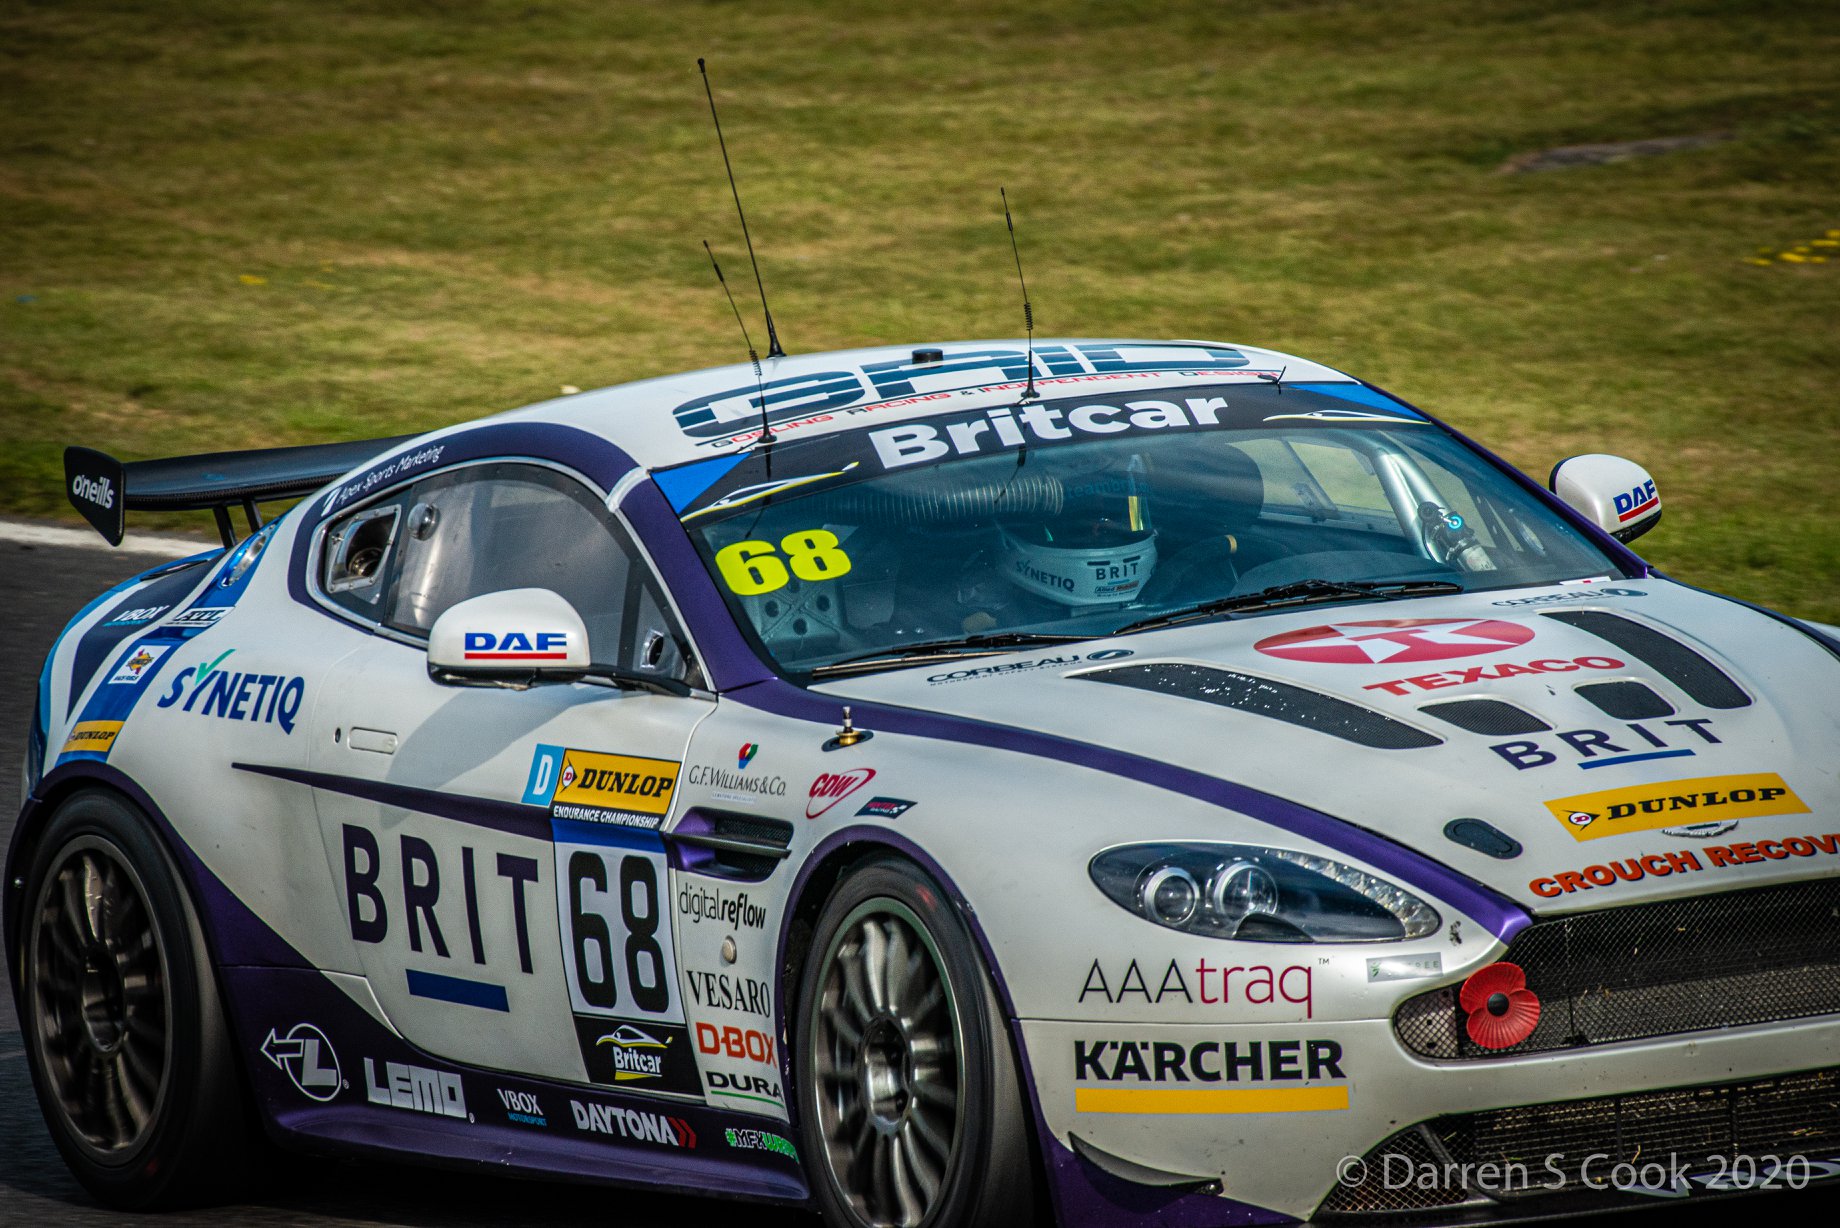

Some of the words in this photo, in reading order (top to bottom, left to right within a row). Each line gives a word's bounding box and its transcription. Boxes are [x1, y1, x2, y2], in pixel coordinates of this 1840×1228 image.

[846, 393, 952, 416] RACING
[979, 371, 1161, 393] INDEPENDENT
[868, 396, 1228, 469] Britcar
[363, 465, 396, 492] Sports
[395, 445, 445, 473] Marketing
[1612, 478, 1656, 515] DAF
[714, 528, 852, 596] 68
[1015, 559, 1075, 592] SYNETIQ
[1095, 563, 1139, 581] BRIT
[112, 604, 171, 622] VBOX
[464, 632, 567, 651] DAF
[926, 654, 1080, 683] CORBEAU
[1362, 655, 1626, 697] TEXACO
[157, 648, 305, 736] SYNETIQ
[75, 730, 116, 741] DUNLOP
[1488, 717, 1723, 772] BRIT
[532, 754, 554, 796] D
[577, 767, 674, 798] DUNLOP
[808, 772, 860, 798] CDW
[553, 804, 601, 822] ENDURANCE
[600, 811, 660, 829] CHAMPIONSHIP
[1606, 787, 1786, 821] DUNLOP
[1529, 849, 1702, 898] CROUCH
[342, 823, 539, 975] BRIT
[568, 850, 671, 1014] 68
[686, 969, 771, 1019] VESARO
[1078, 956, 1313, 1020] AAAtraq
[612, 1045, 662, 1074] Britcar
[695, 1021, 778, 1069] D-BOX
[1074, 1039, 1348, 1082] KÄRCHER
[363, 1056, 468, 1119] LEMO
[497, 1087, 544, 1116] VBOX
[507, 1111, 548, 1128] MOTORSPORT
[569, 1099, 680, 1147] DAYTONA
